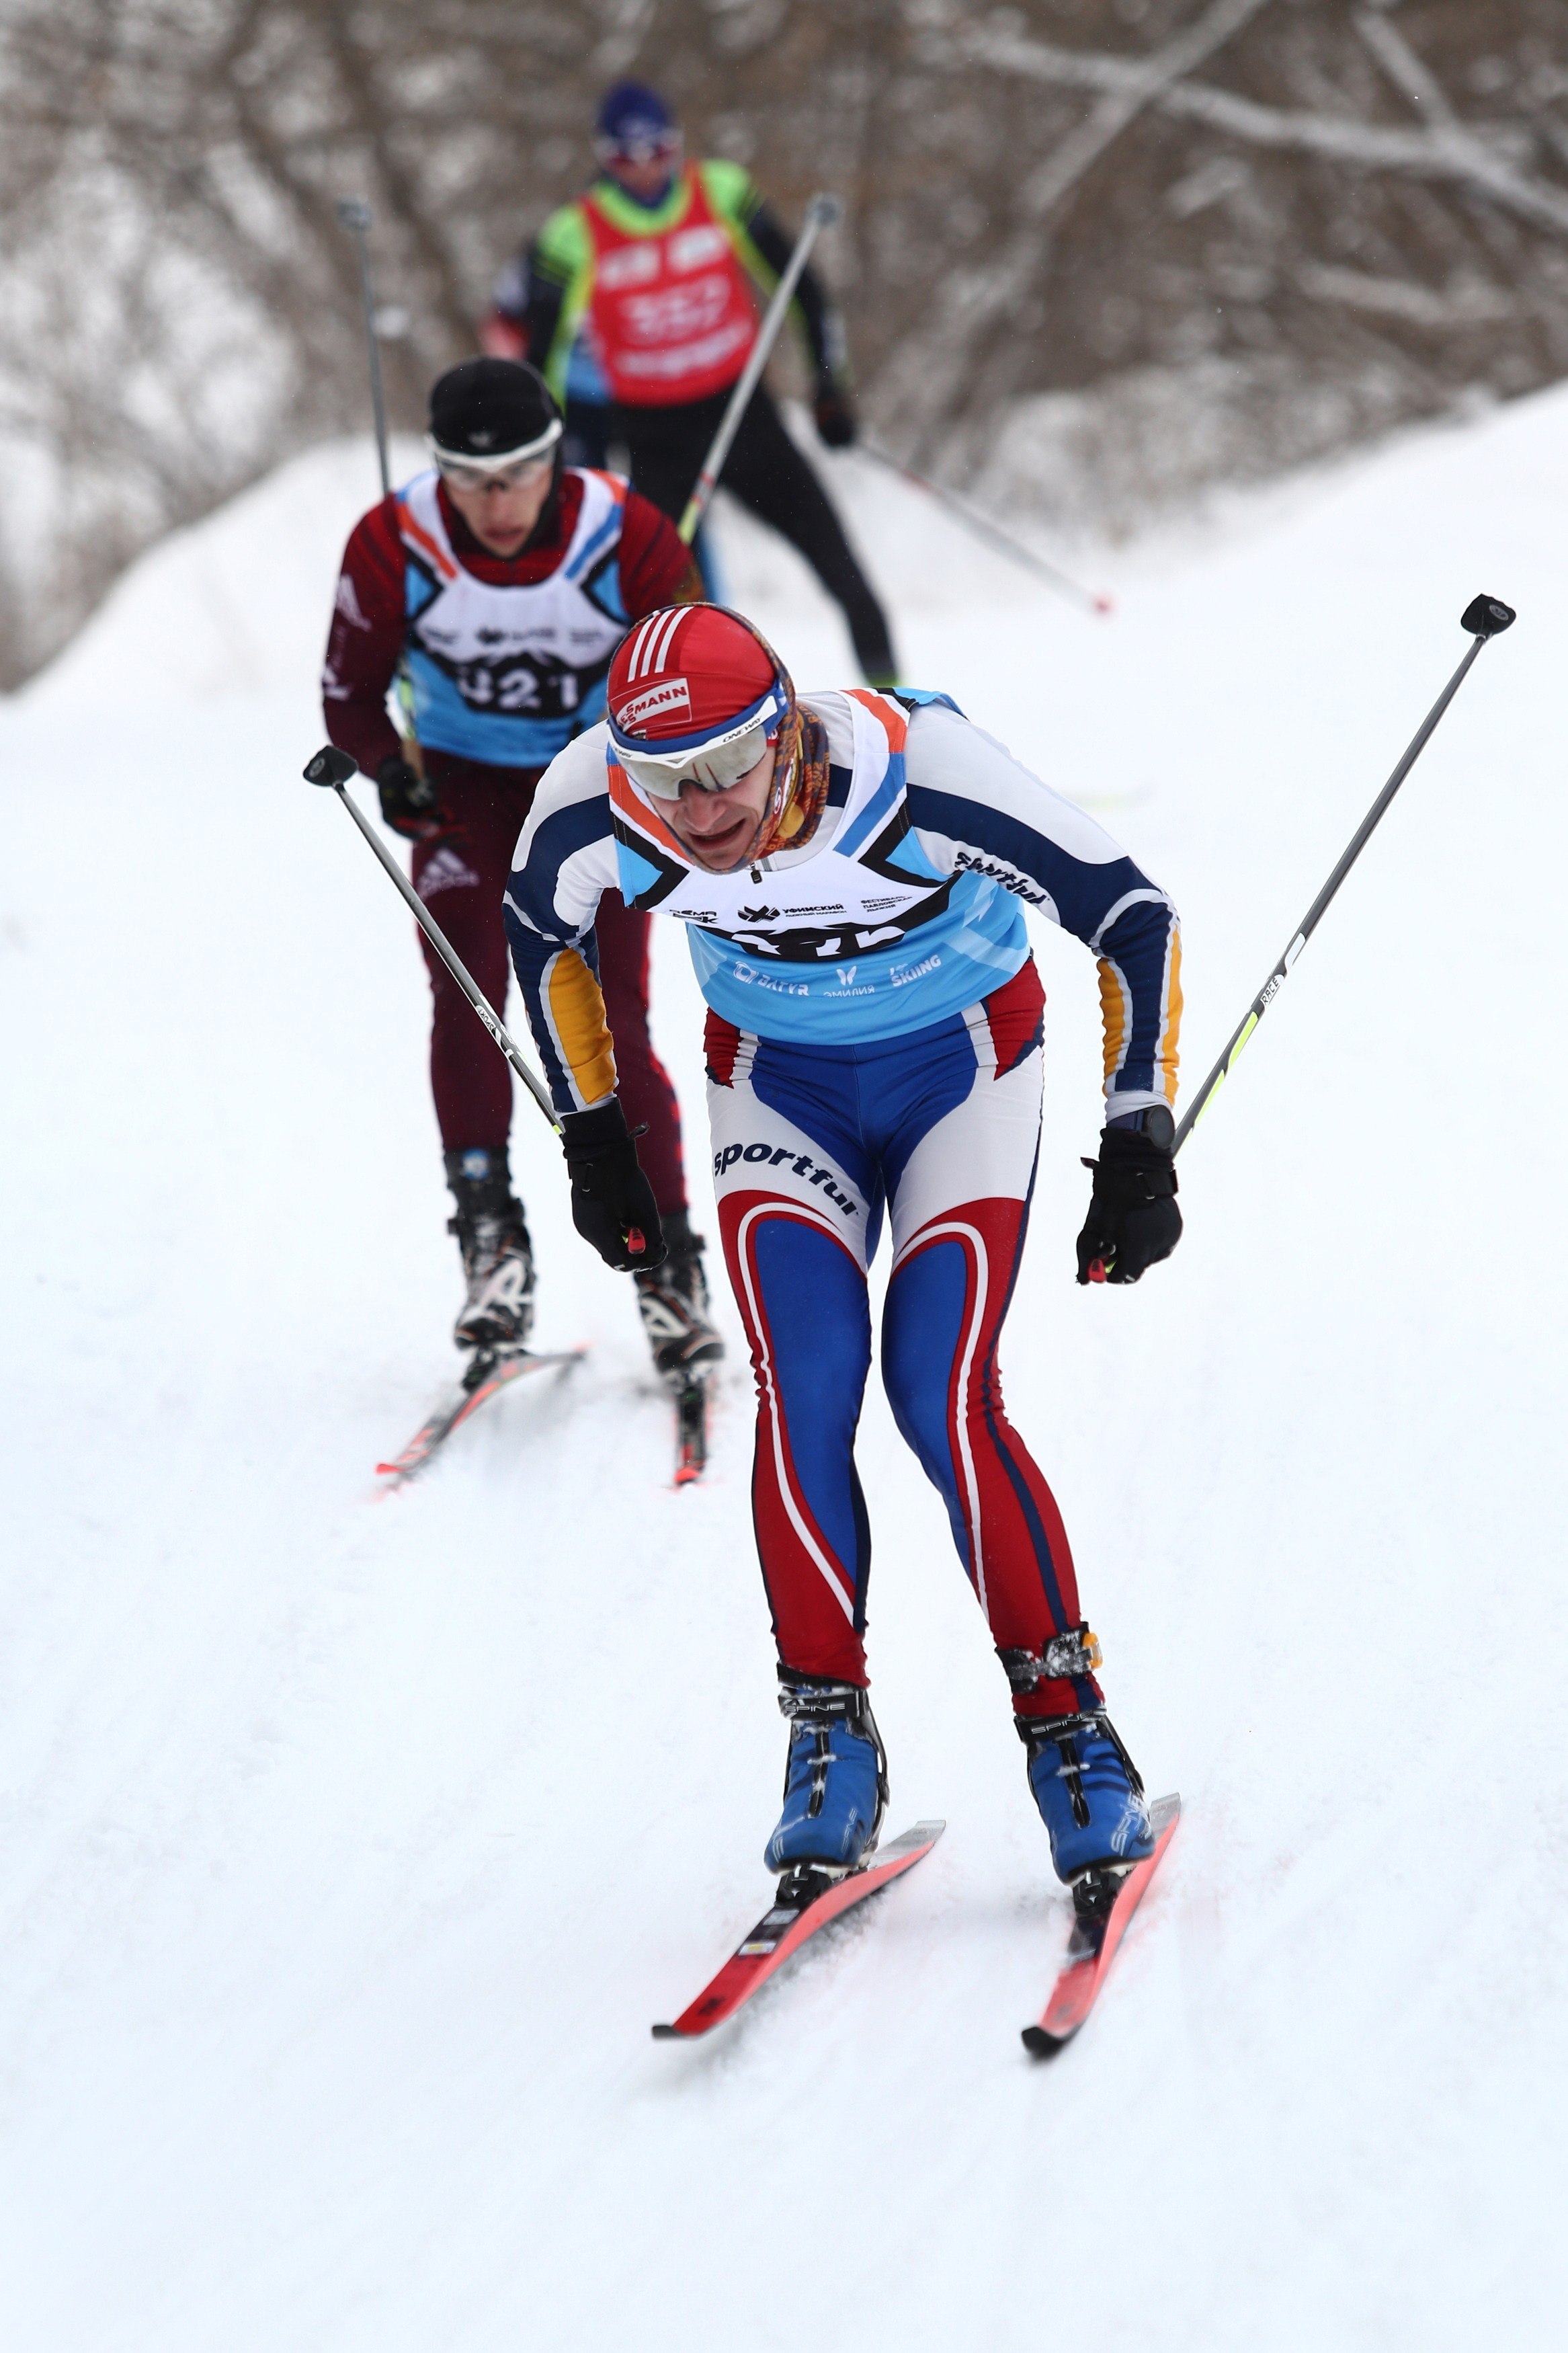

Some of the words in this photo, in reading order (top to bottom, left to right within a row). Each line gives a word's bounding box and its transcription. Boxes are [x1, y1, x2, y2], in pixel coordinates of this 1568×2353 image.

[782, 903, 844, 914] УФИМСКИЙ
[891, 955, 942, 987] SKIING
[1261, 977, 1279, 1006] RACE
[478, 1008, 496, 1031] SPORT
[785, 1703, 845, 1713] SPINE
